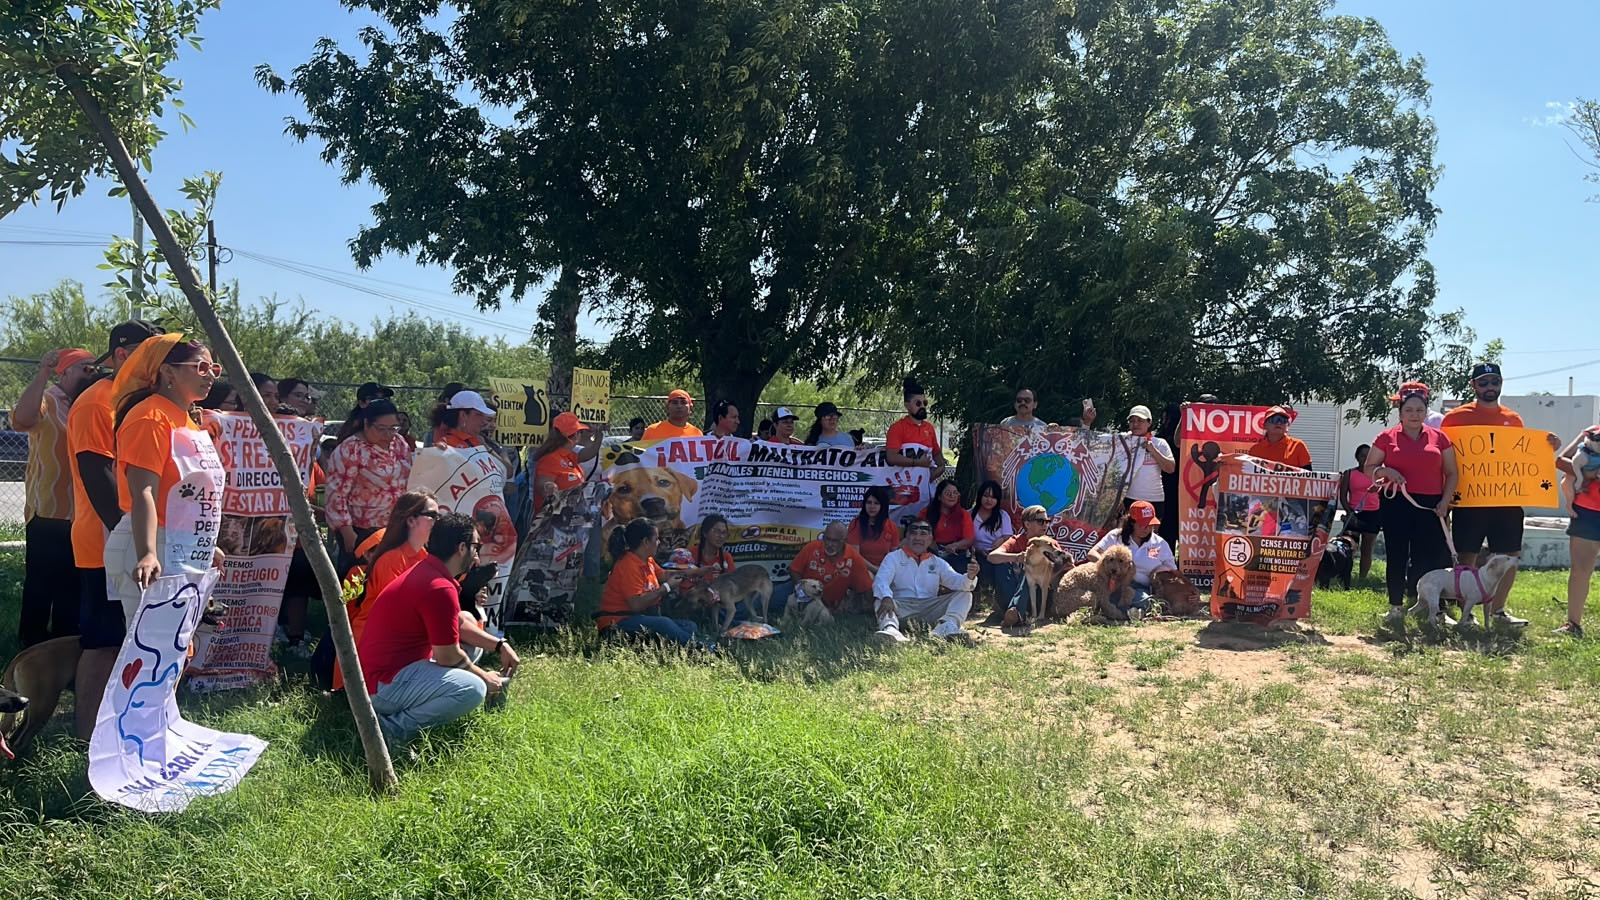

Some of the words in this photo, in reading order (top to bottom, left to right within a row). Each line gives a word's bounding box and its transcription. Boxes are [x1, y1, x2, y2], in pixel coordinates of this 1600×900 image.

[493, 395, 524, 411] SIENTEN
[573, 403, 606, 422] CRUZAR
[233, 418, 296, 441] PEDOS
[1451, 432, 1495, 457] NO!
[1512, 435, 1537, 456] AL
[220, 441, 238, 468] SE
[747, 444, 857, 467] MALTRATO
[757, 466, 794, 478] TIENEN
[797, 468, 858, 482] DERECHOS
[1462, 461, 1539, 478] MALTRATO
[837, 486, 869, 494] MALTR
[1228, 474, 1300, 496] BIENESTAR
[1467, 482, 1530, 499] ANIMAL
[1188, 508, 1205, 518] NO
[1180, 522, 1199, 531] NO
[1202, 522, 1210, 531] A
[1180, 535, 1199, 544] NO
[1202, 535, 1209, 545] A
[1260, 539, 1282, 548] CENSE
[1283, 541, 1288, 549] A
[1289, 541, 1302, 550] LOS
[722, 543, 768, 553] OTÉGELOS
[1188, 548, 1205, 558] NO
[1260, 548, 1276, 557] PARA
[1277, 550, 1297, 558] EVITAR
[223, 560, 254, 568] EREMOS
[1278, 565, 1297, 573] CALLES
[232, 568, 279, 582] REFUGIO
[207, 643, 267, 654] INSPECTORES
[213, 653, 265, 662] SANCIONES
